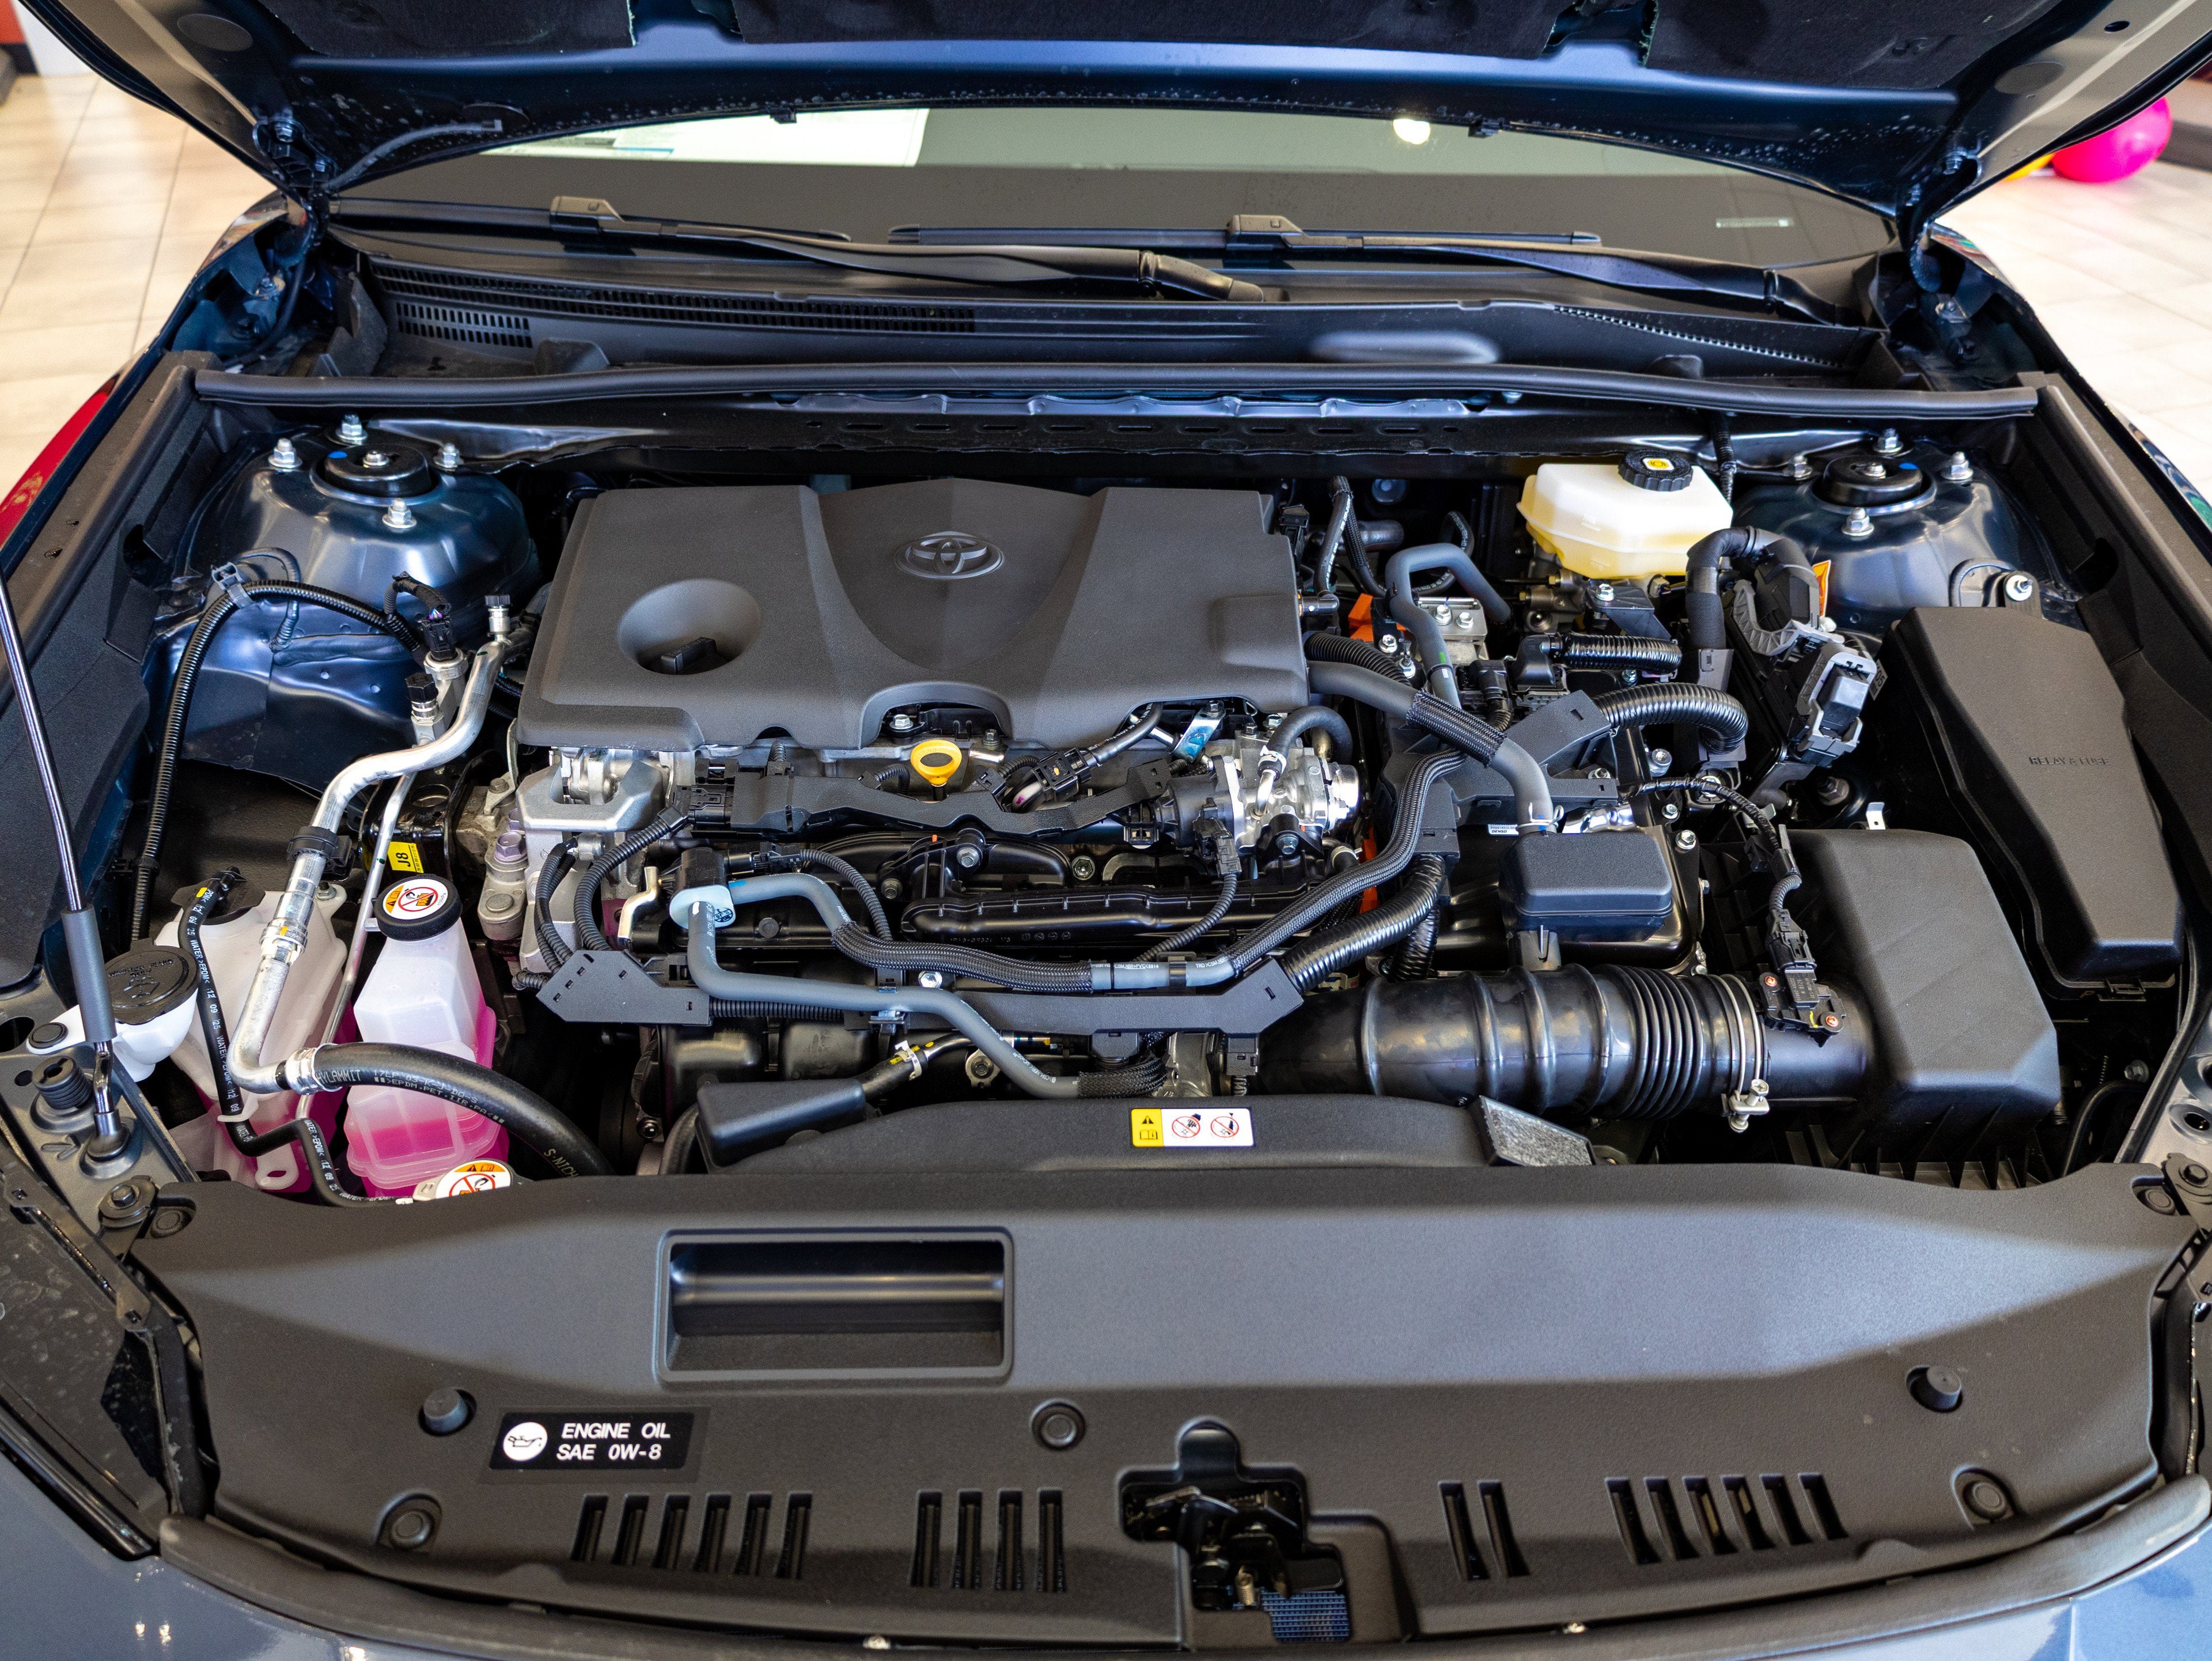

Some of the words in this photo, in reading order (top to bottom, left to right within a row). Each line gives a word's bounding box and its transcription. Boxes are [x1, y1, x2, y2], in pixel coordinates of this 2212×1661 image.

[2028, 756, 2066, 765] RELAY
[2079, 756, 2111, 765] FUSE
[395, 852, 411, 868] J8
[190, 939, 203, 959] WATER
[217, 1035, 228, 1060] WATER
[304, 1119, 318, 1134] WATER
[561, 1422, 631, 1439] ENGINE
[641, 1422, 671, 1439] OIL
[556, 1444, 597, 1460] SAE
[608, 1444, 662, 1461] 0W-8
